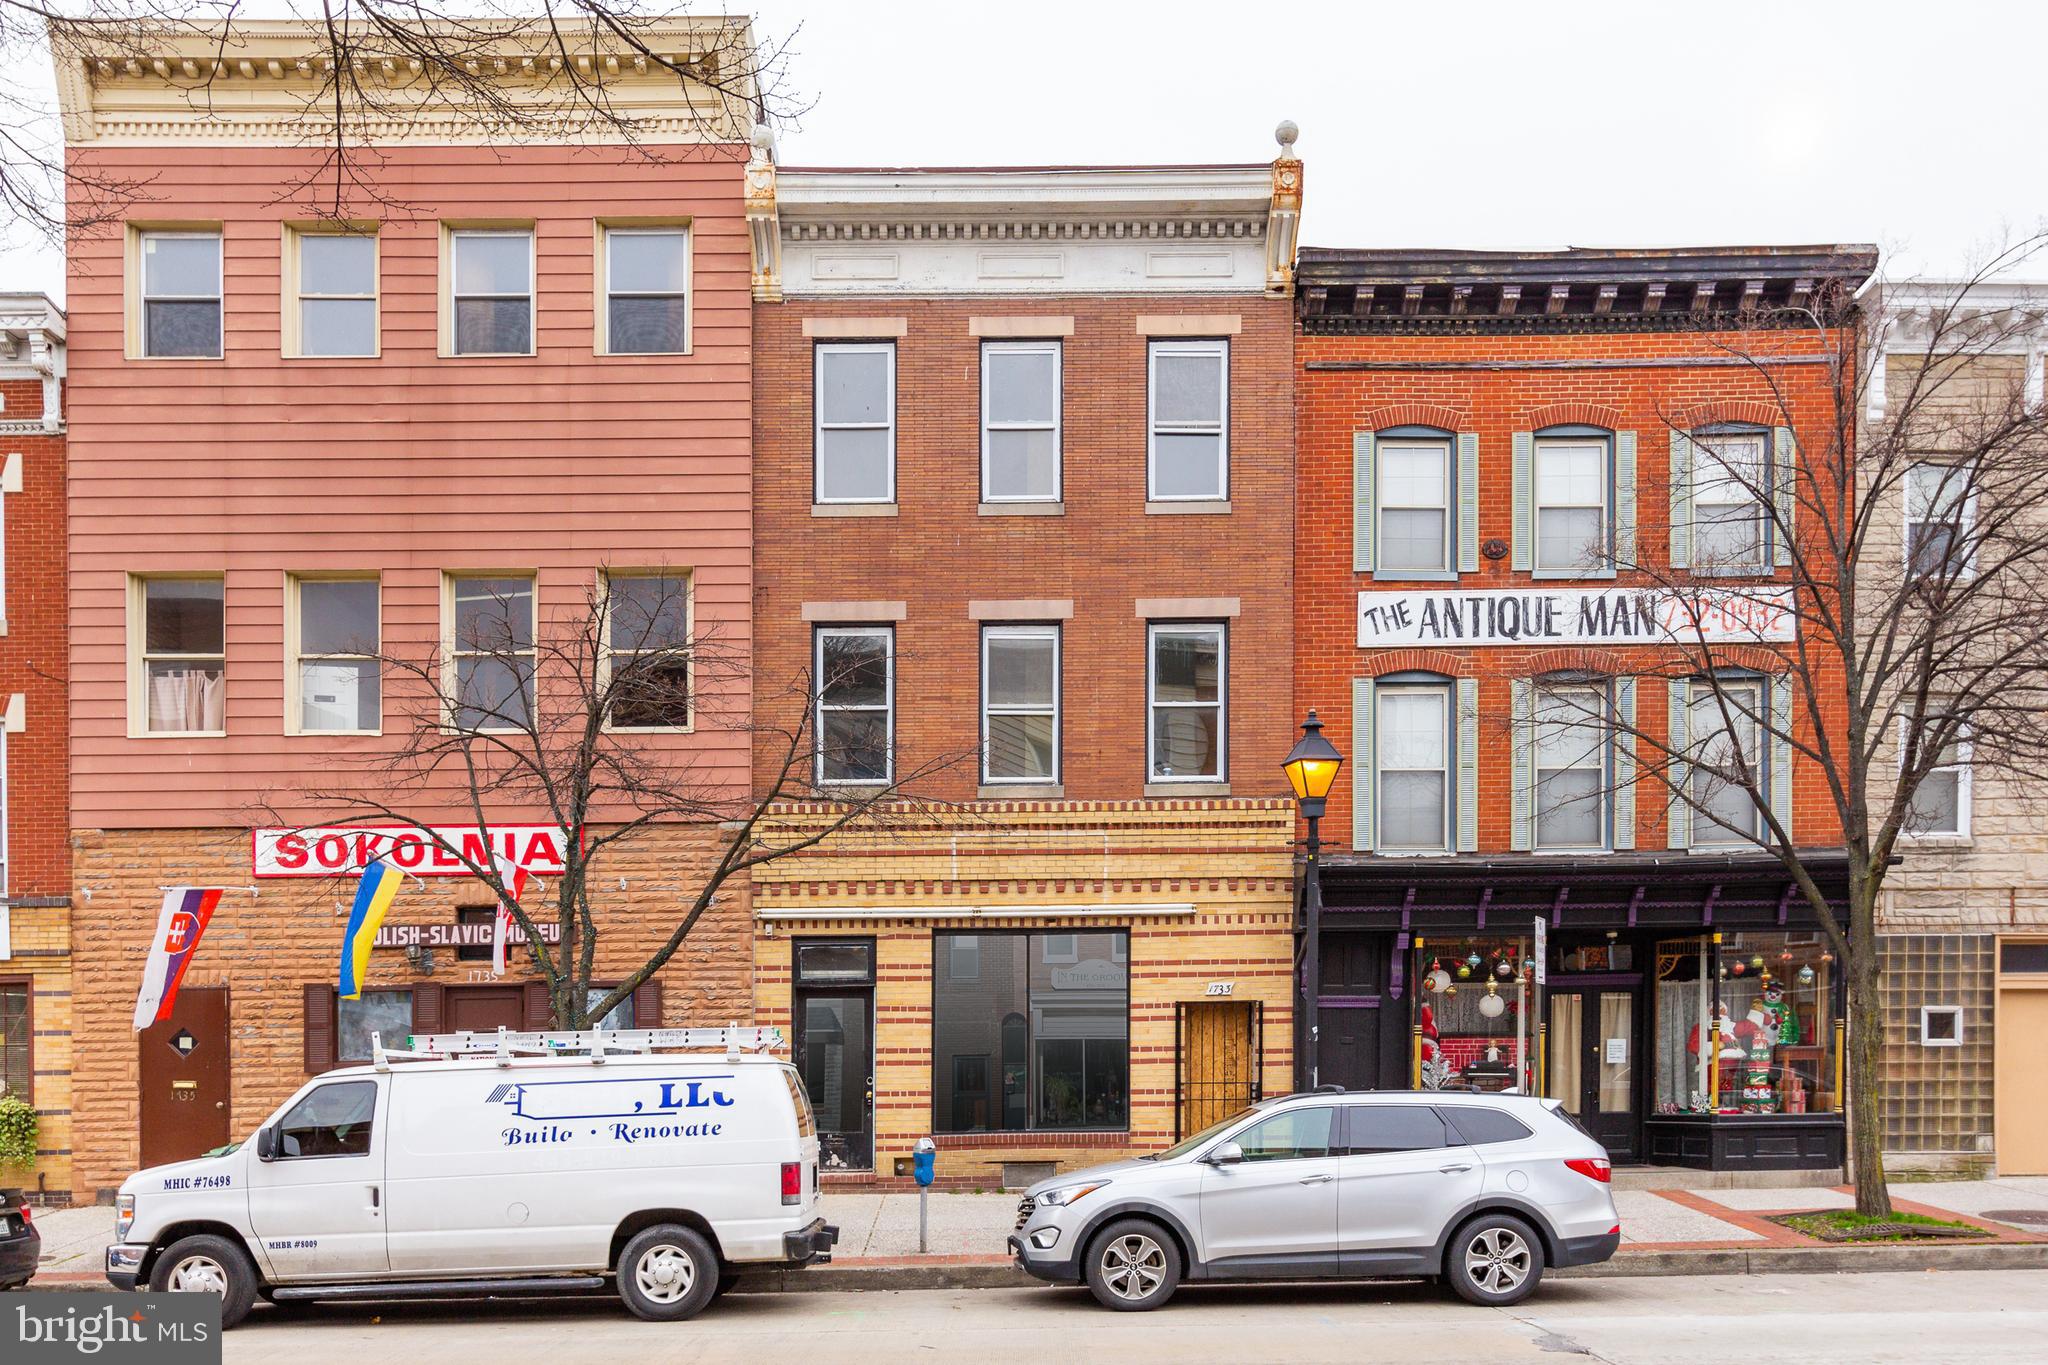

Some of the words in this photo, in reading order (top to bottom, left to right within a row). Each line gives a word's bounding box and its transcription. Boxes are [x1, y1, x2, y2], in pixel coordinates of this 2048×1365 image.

[1363, 598, 1413, 635] THE
[1417, 596, 1563, 640] ANTIQUE
[1577, 595, 1656, 637] MAN
[275, 832, 562, 868] SOKOLNIA
[373, 924, 493, 945] OLISH-SLAVIC
[608, 1122, 722, 1143] Renovate
[163, 1177, 191, 1190] MHIC
[193, 1175, 231, 1189] #76498
[268, 1241, 292, 1249] MHBR
[294, 1240, 318, 1249] #8009
